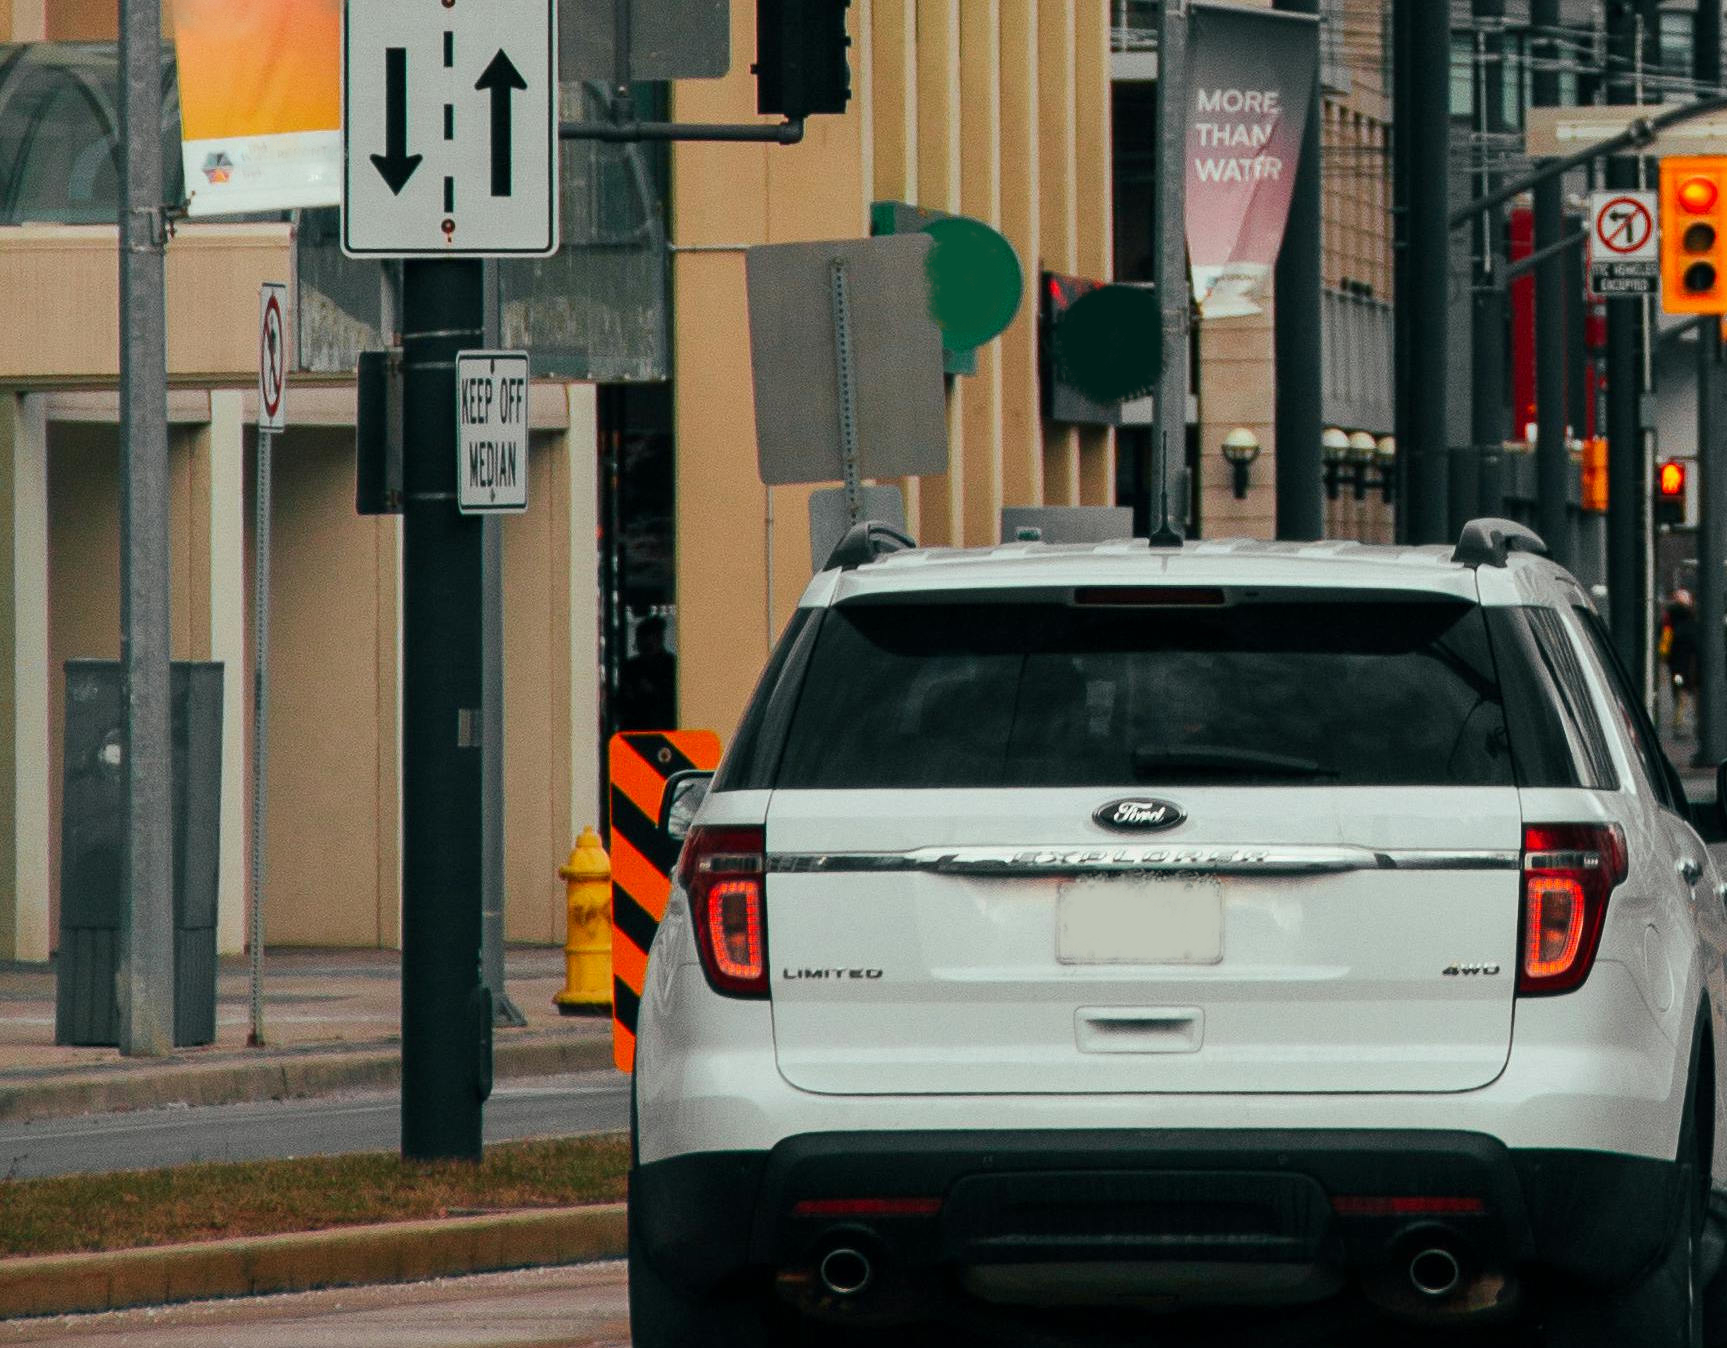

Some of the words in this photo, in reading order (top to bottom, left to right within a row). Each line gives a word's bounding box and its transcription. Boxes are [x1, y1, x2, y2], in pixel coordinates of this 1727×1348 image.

[1198, 88, 1281, 114] MORE
[1195, 123, 1273, 147] THAN
[461, 377, 493, 425] KEEP
[499, 377, 524, 425] OFF
[469, 441, 517, 488] MEDIAN
[1113, 801, 1166, 825] Ford
[1008, 849, 1270, 864] EXPLORER
[783, 966, 884, 980] LIMITED
[1442, 962, 1501, 976] 4WD
